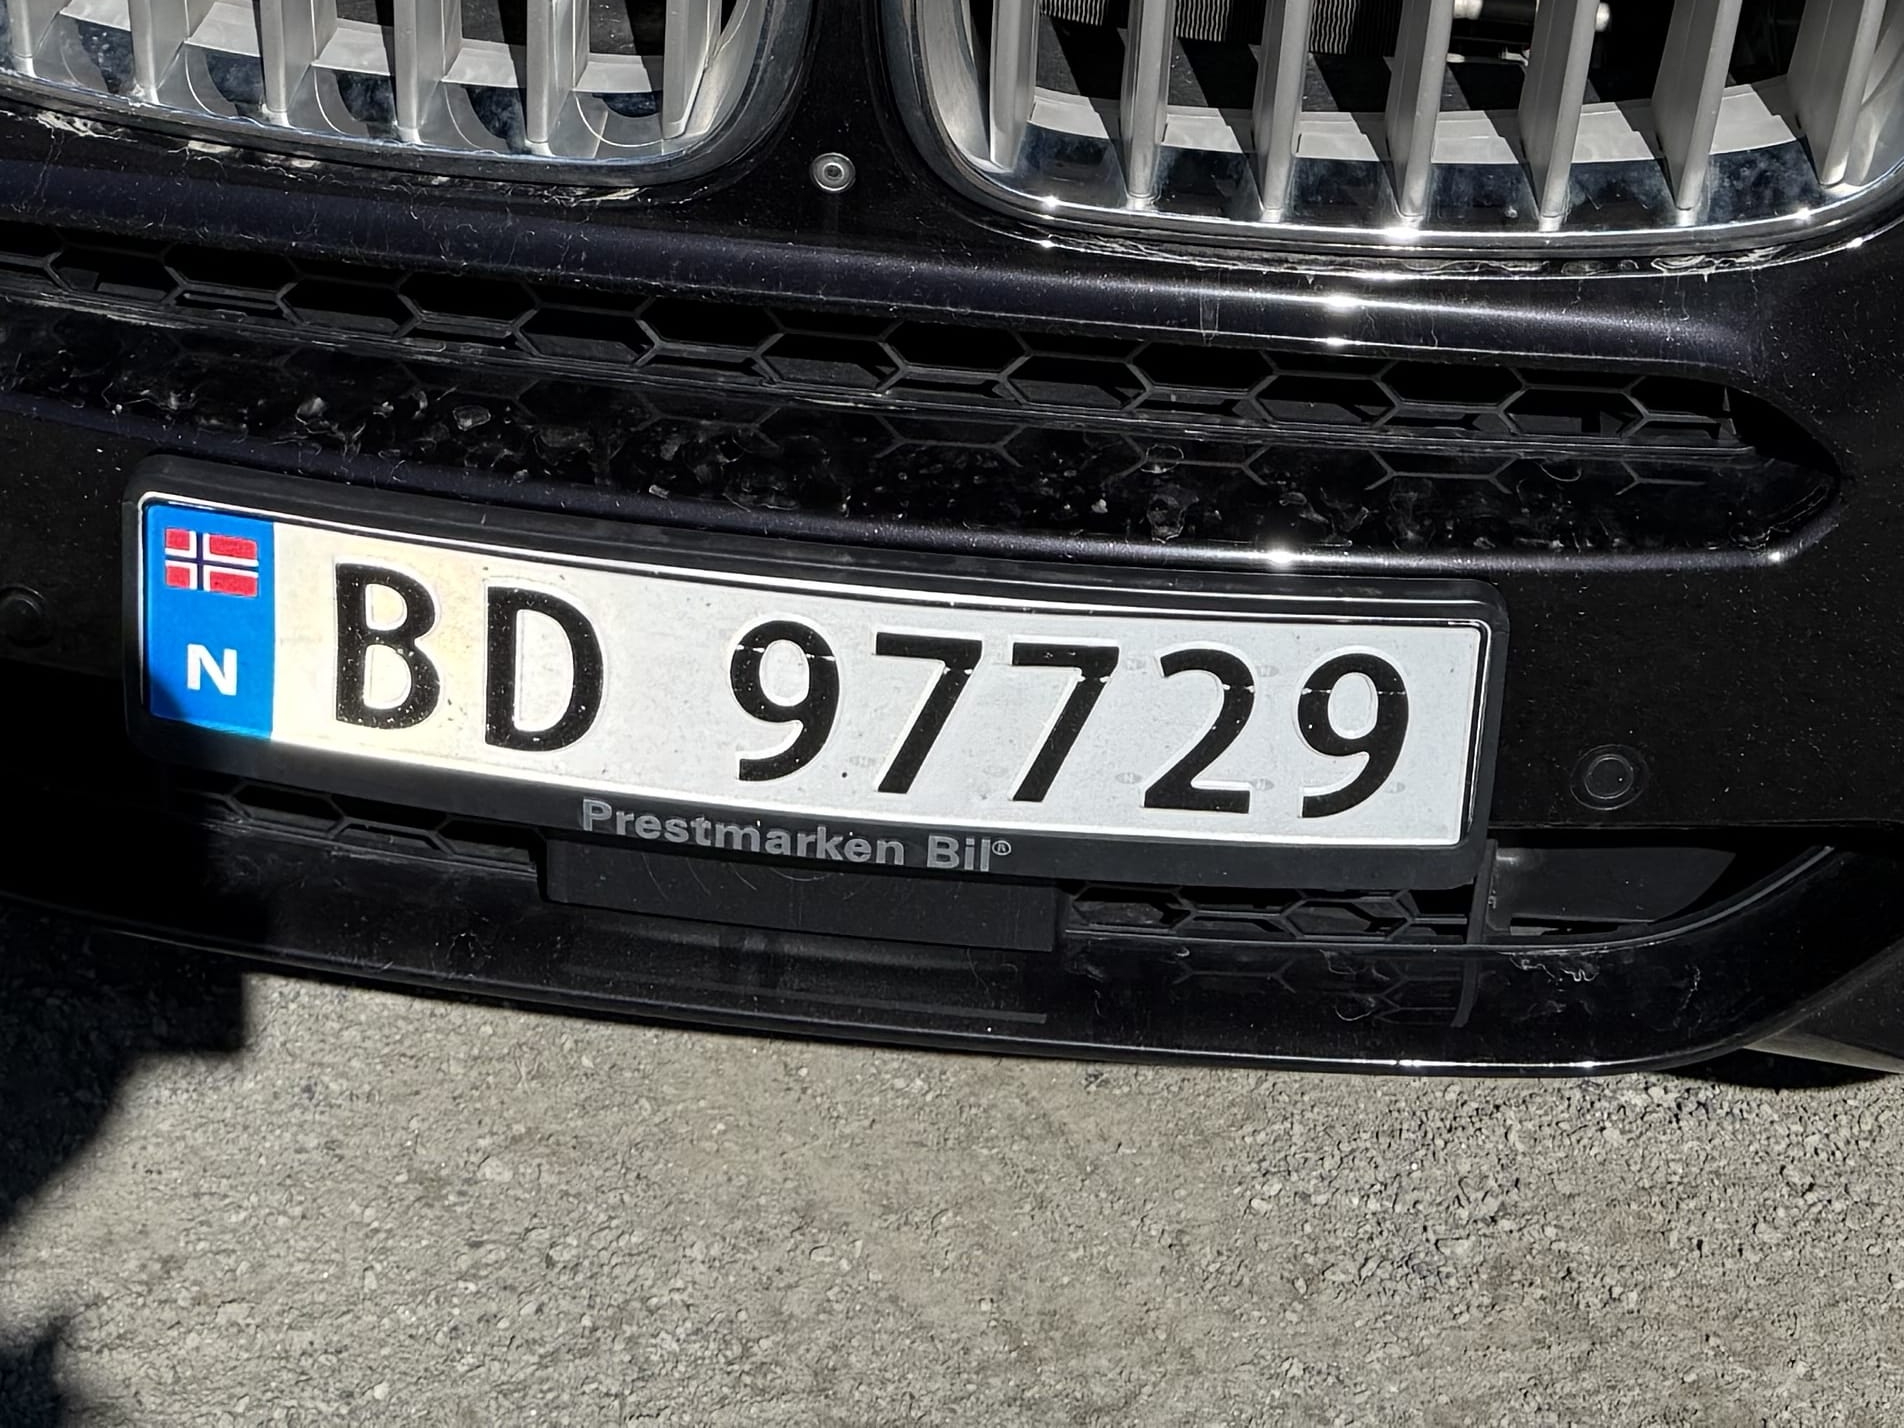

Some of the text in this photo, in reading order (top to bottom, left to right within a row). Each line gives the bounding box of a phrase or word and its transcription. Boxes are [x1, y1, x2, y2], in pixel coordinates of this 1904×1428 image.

[186, 643, 238, 696] N
[333, 562, 1411, 819] BD 97729
[579, 797, 906, 866] Prestmarken
